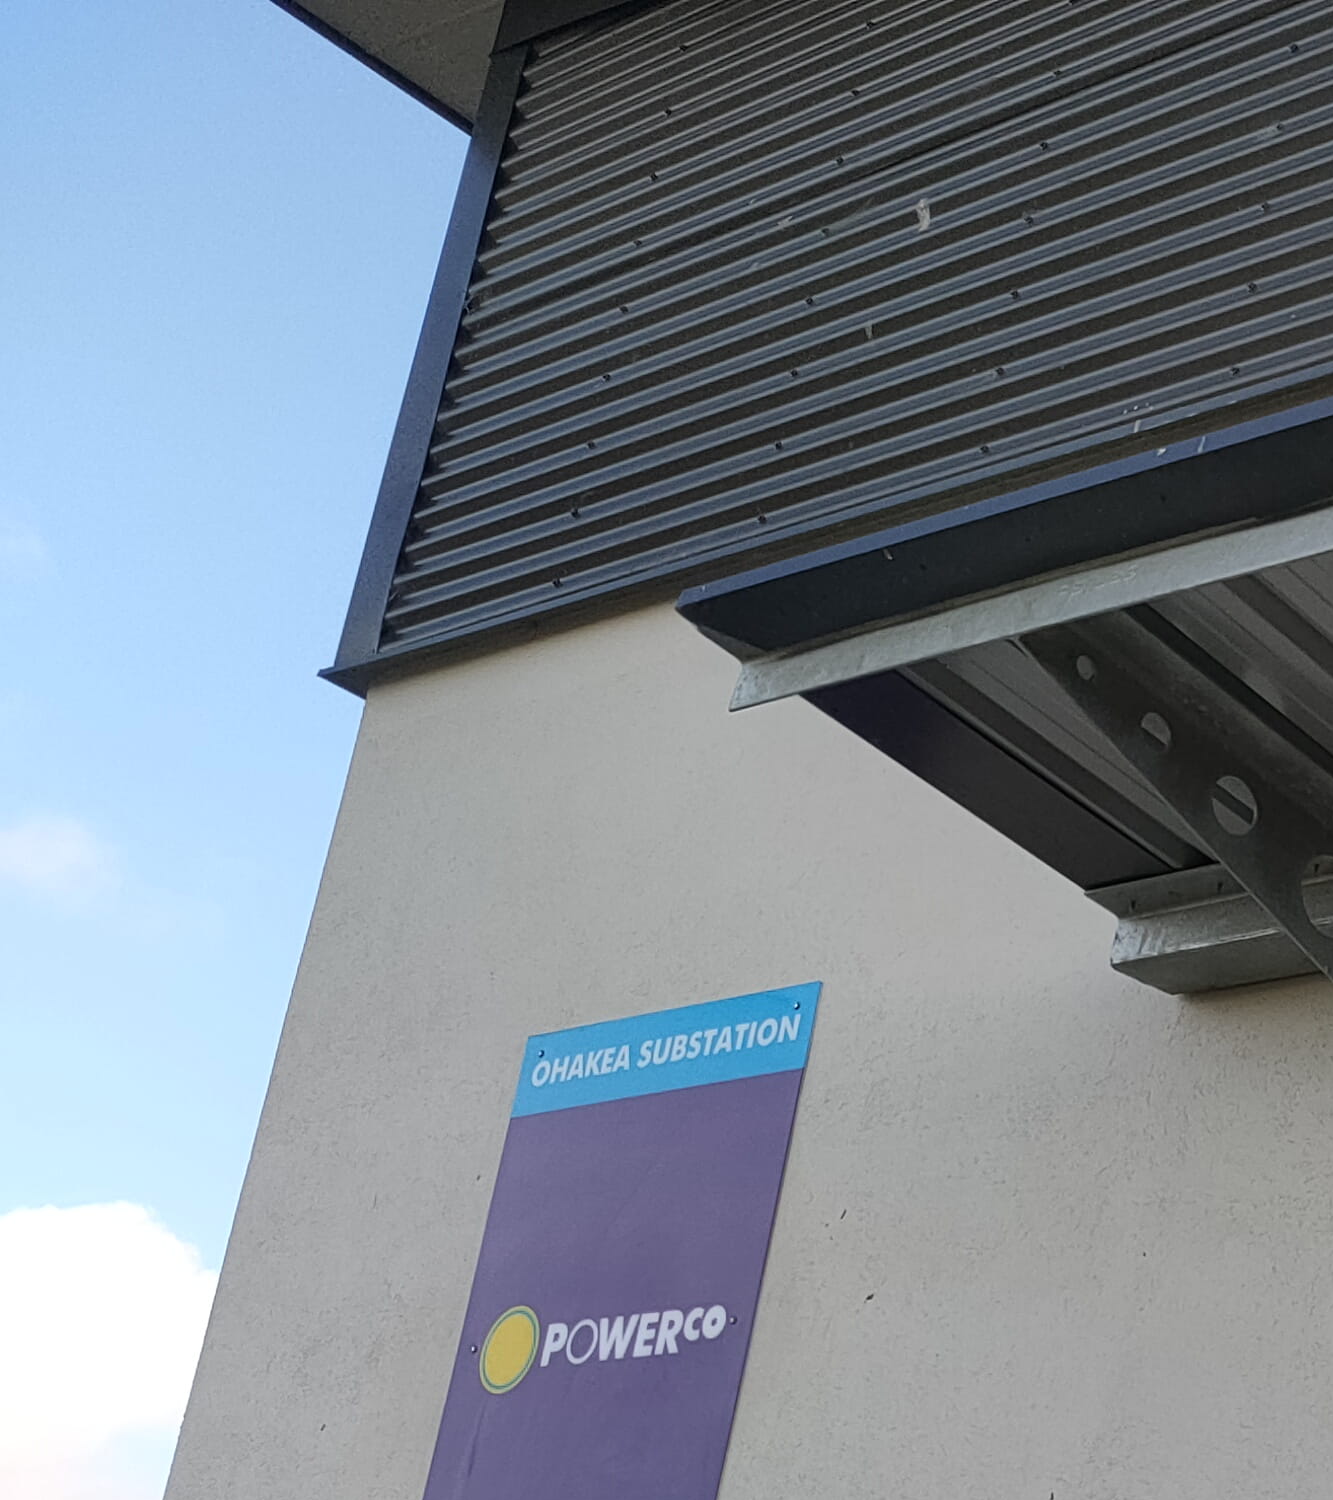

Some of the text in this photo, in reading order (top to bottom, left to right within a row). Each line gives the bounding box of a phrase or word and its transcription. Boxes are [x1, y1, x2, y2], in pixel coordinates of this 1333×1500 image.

[532, 1014, 801, 1087] OHAKEA SUBSTATION
[541, 1304, 726, 1367] POWERCO
